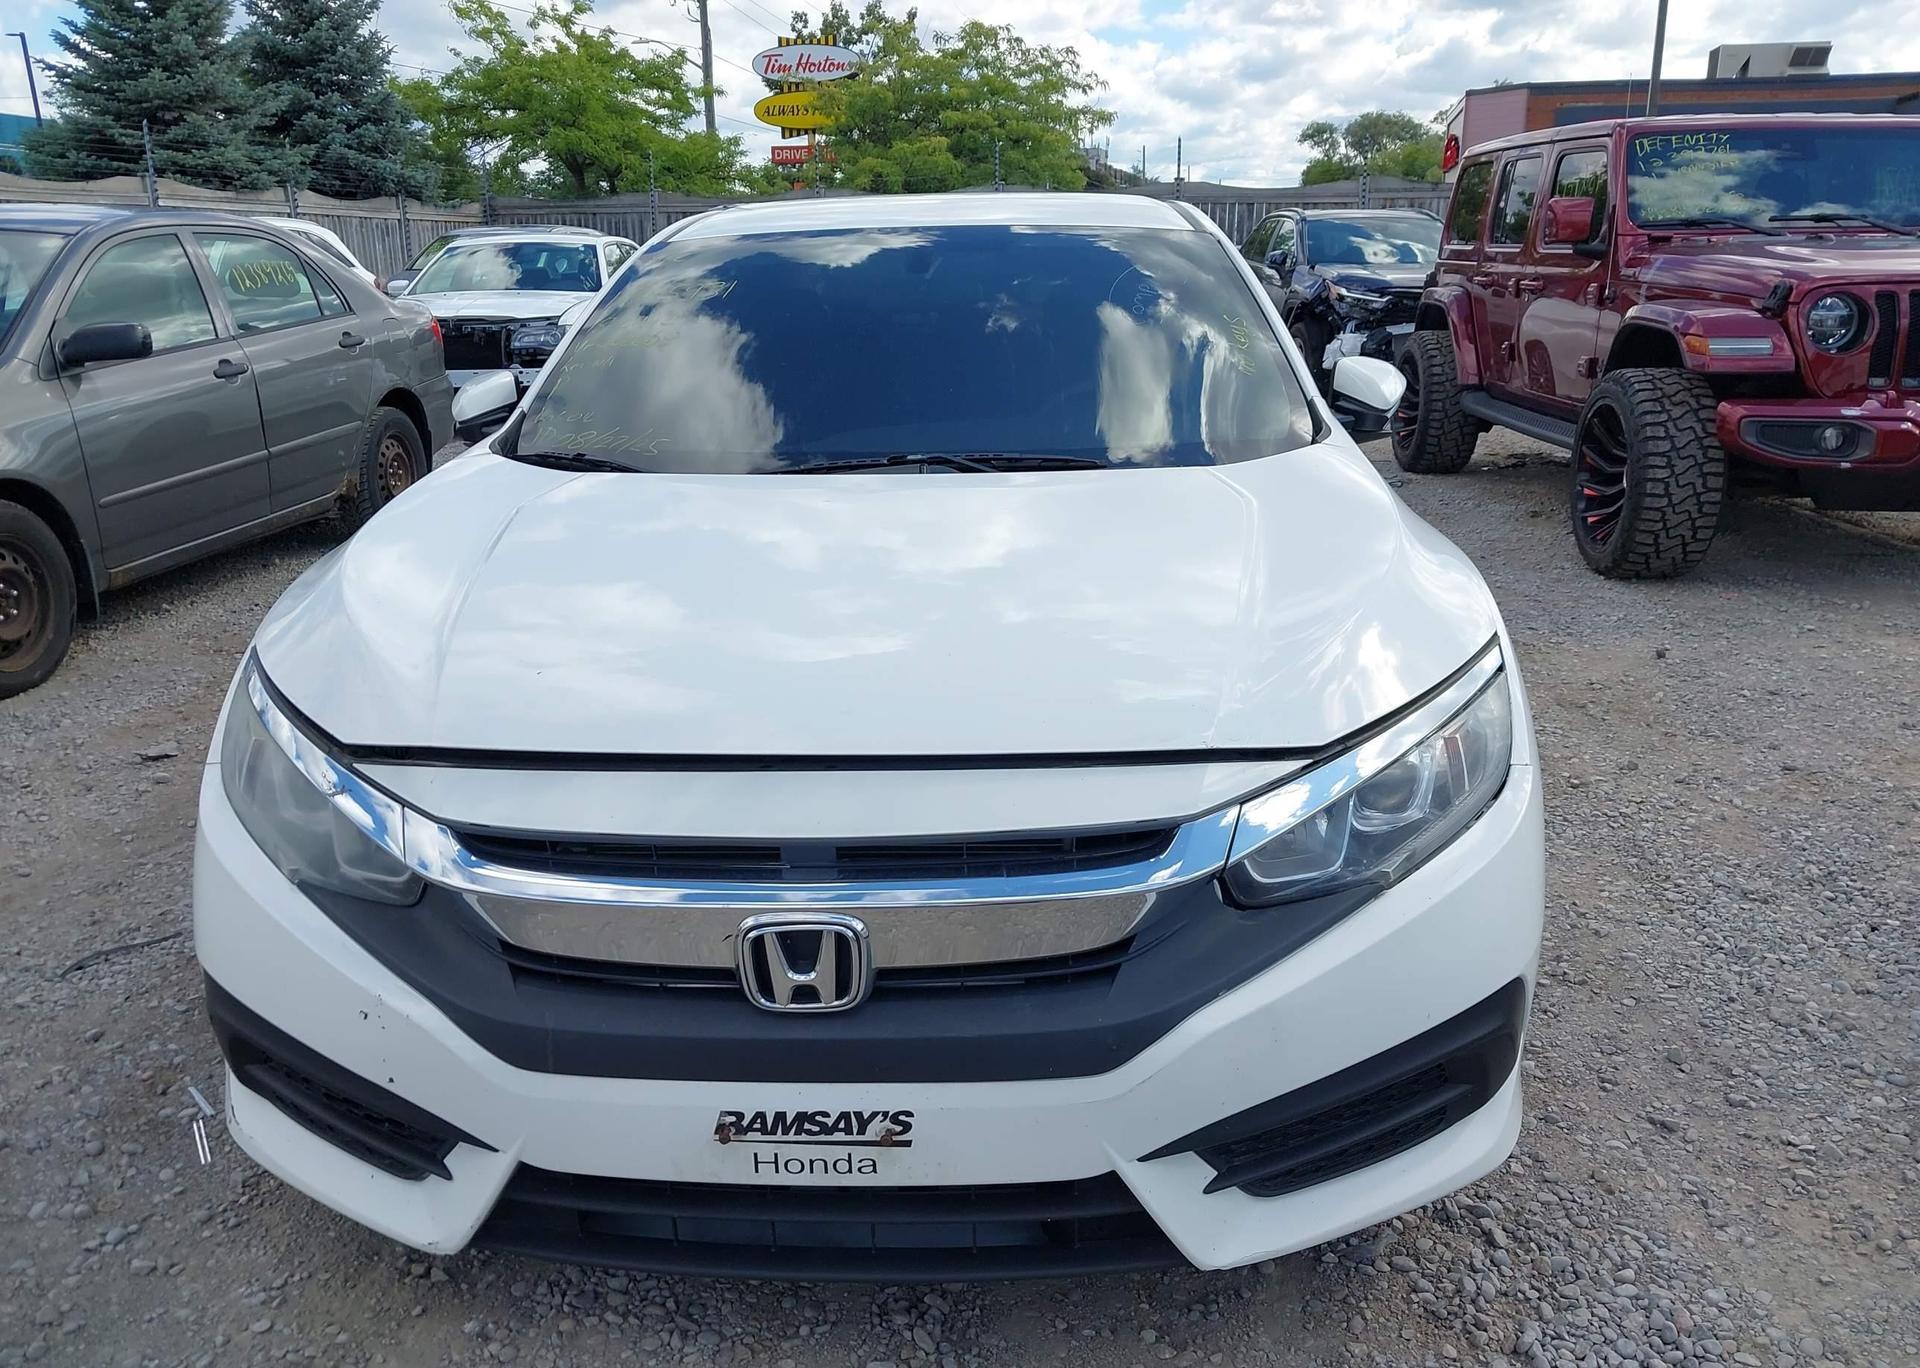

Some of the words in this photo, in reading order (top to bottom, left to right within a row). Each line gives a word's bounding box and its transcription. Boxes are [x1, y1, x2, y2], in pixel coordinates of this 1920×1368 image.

[762, 53, 793, 75] Tim
[796, 52, 853, 74] Horton
[762, 104, 809, 117] ALWAYS
[774, 149, 809, 160] DRIVE
[713, 1109, 915, 1137] RAMSAY'S
[753, 1152, 878, 1175] Honda
